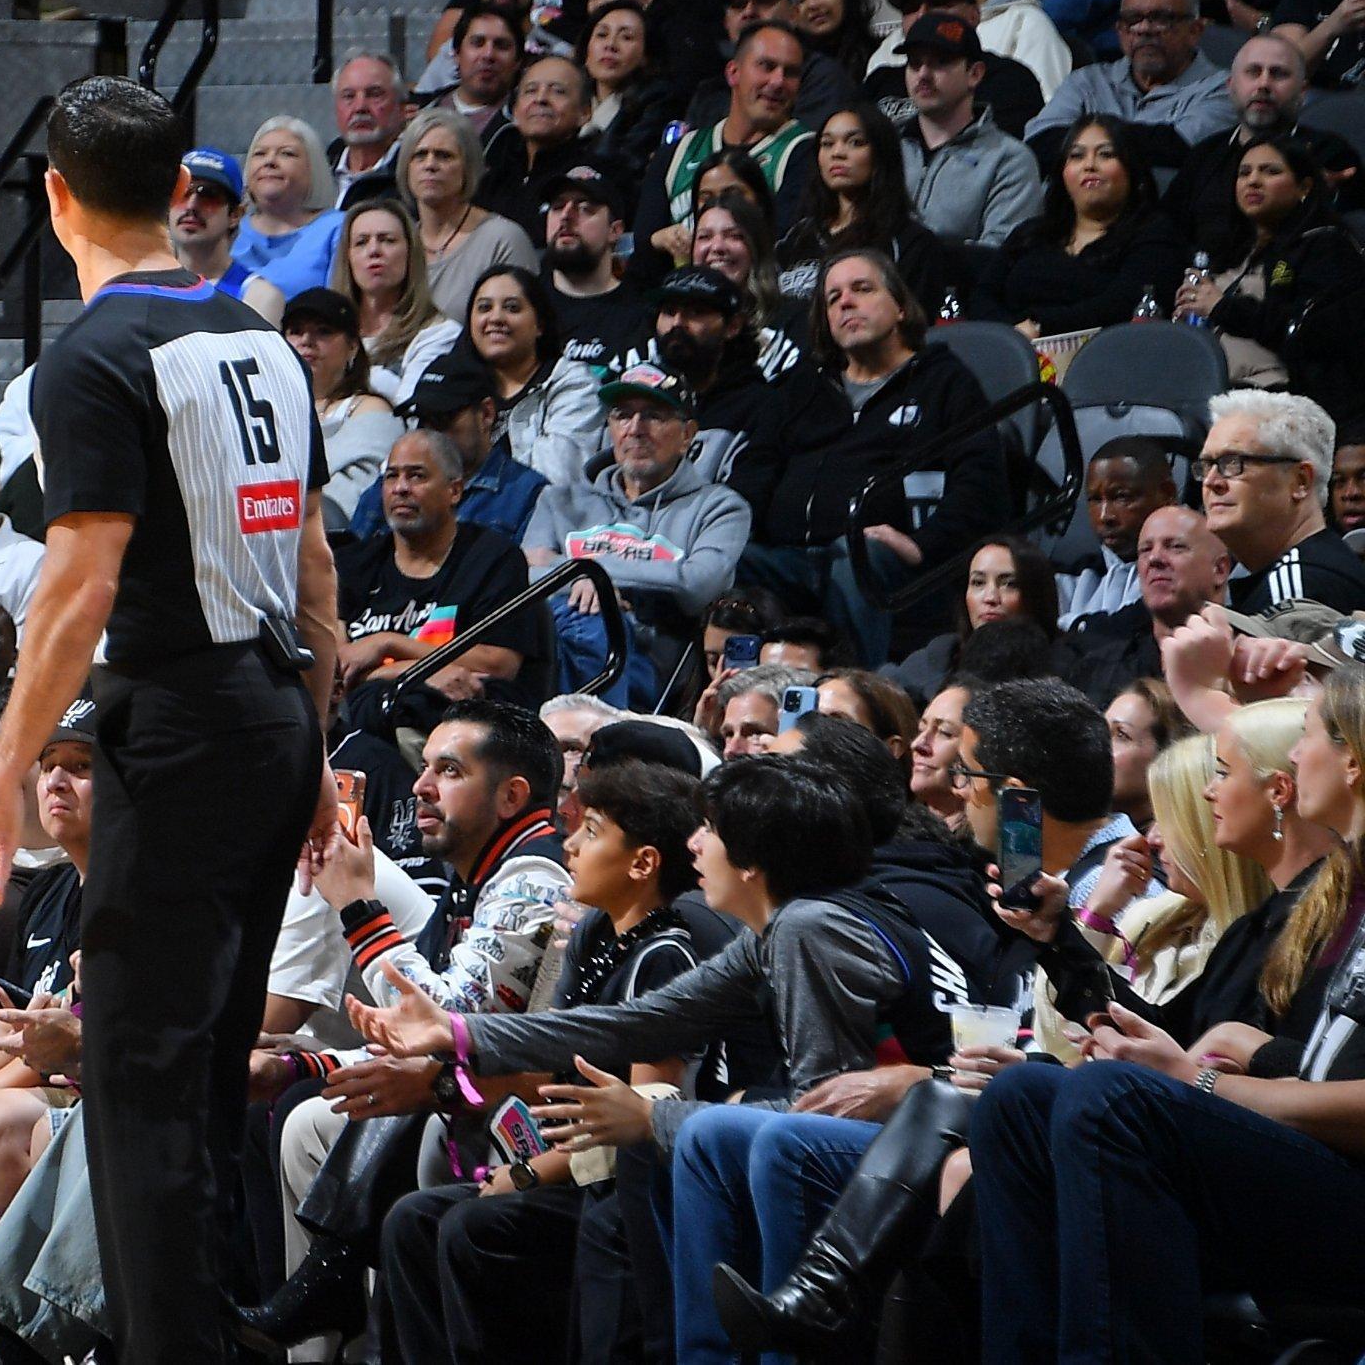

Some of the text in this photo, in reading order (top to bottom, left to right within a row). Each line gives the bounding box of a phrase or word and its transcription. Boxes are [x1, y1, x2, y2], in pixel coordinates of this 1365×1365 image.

[219, 356, 281, 466] 15
[243, 491, 294, 519] Emirates
[349, 602, 393, 639] San
